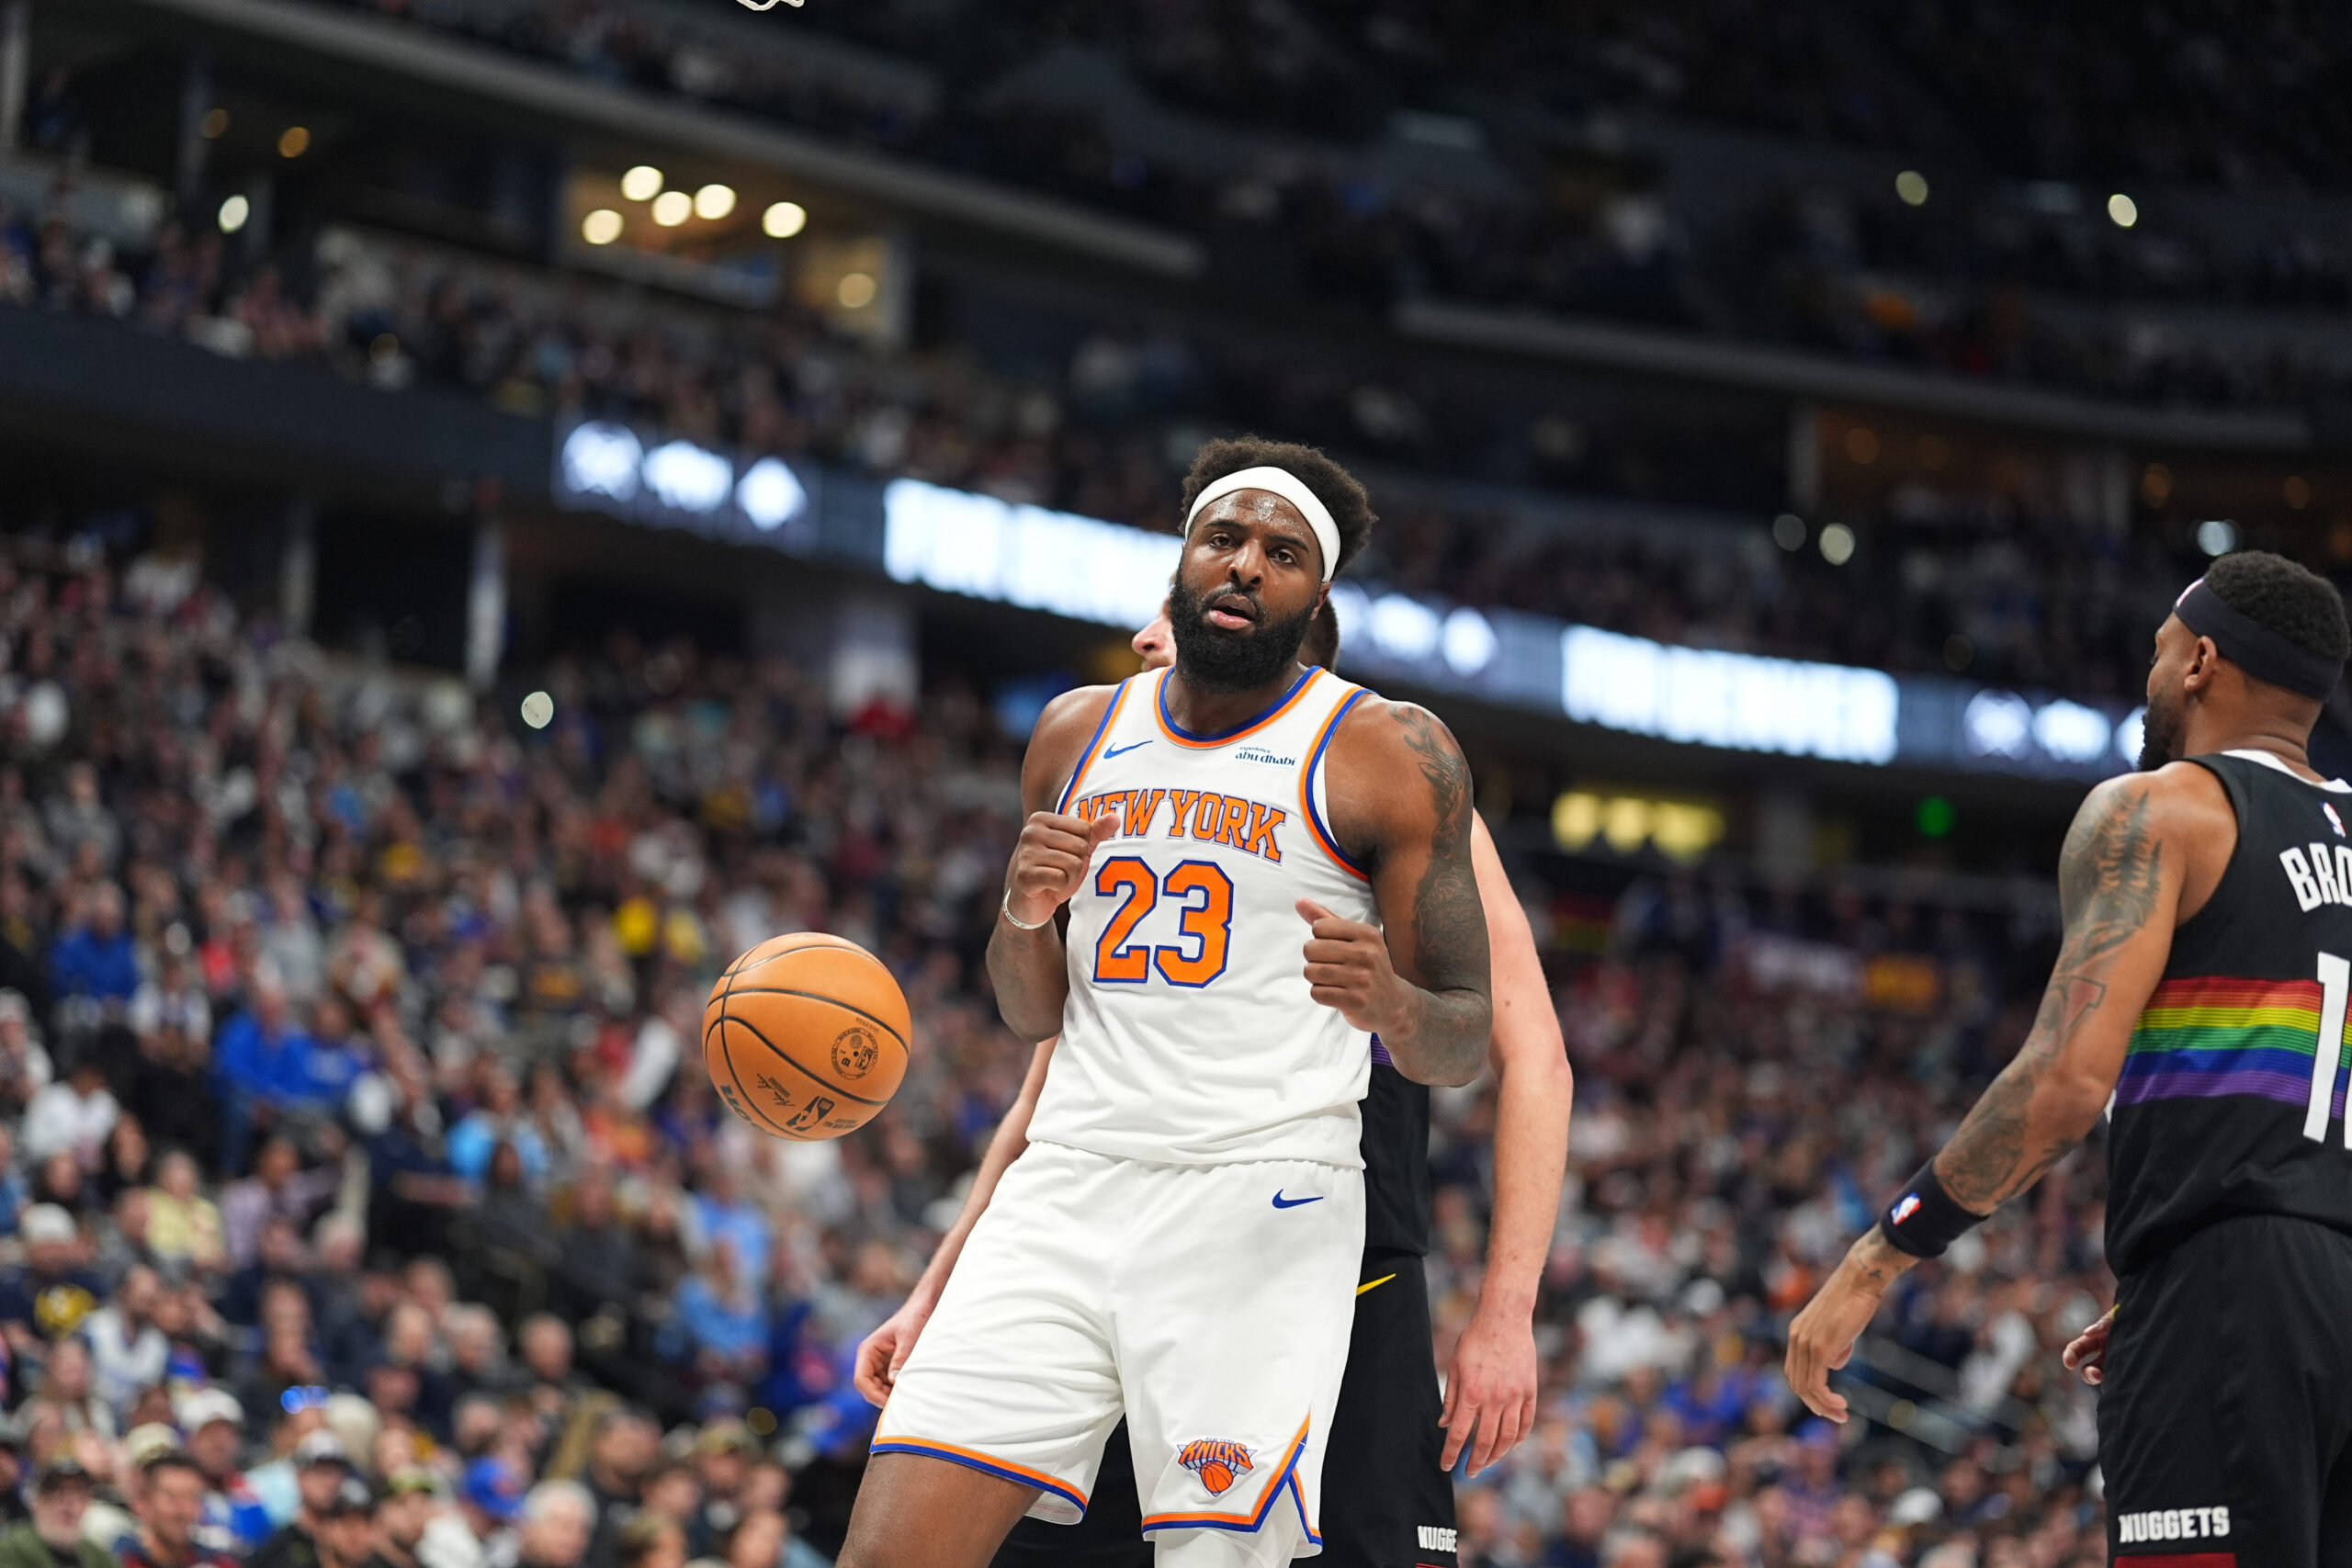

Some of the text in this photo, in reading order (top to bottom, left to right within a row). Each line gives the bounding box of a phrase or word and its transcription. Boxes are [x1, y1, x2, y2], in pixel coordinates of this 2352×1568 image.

[1235, 751, 1297, 766] abu dhabi
[1168, 788, 1286, 863] YORK
[1092, 855, 1235, 988] 23
[2302, 950, 2352, 1150] 1
[1178, 1438, 1254, 1472] KNICKS
[2118, 1506, 2231, 1544] NUGGETS
